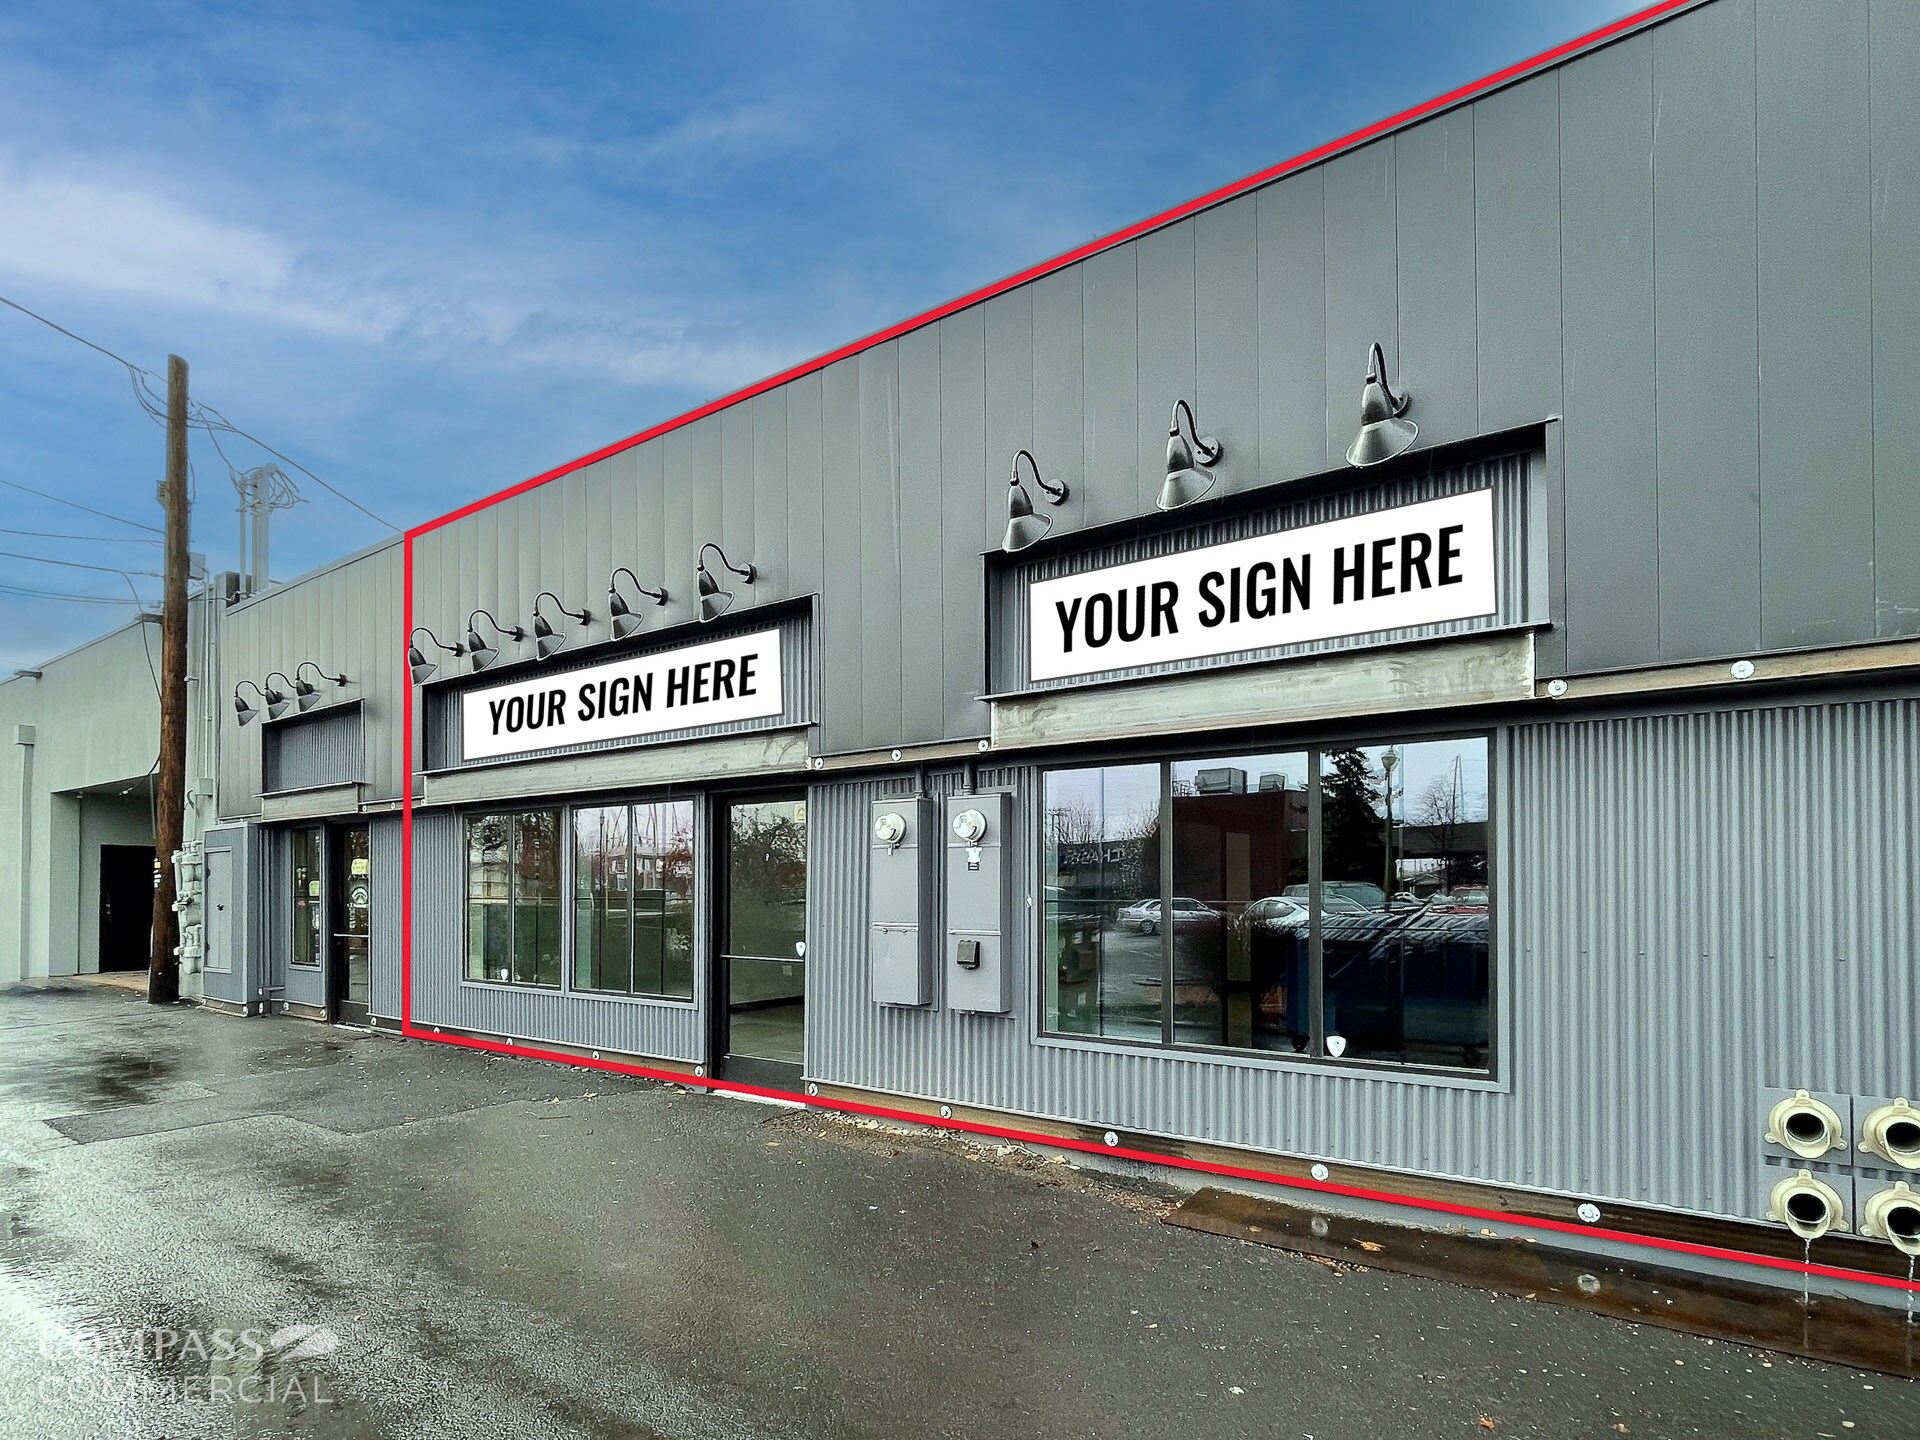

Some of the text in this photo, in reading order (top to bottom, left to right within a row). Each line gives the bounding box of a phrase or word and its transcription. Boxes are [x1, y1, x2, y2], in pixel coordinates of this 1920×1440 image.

[1055, 524, 1464, 653] YOUR SIGN HERE
[488, 653, 759, 736] YOUR SIGN HERE
